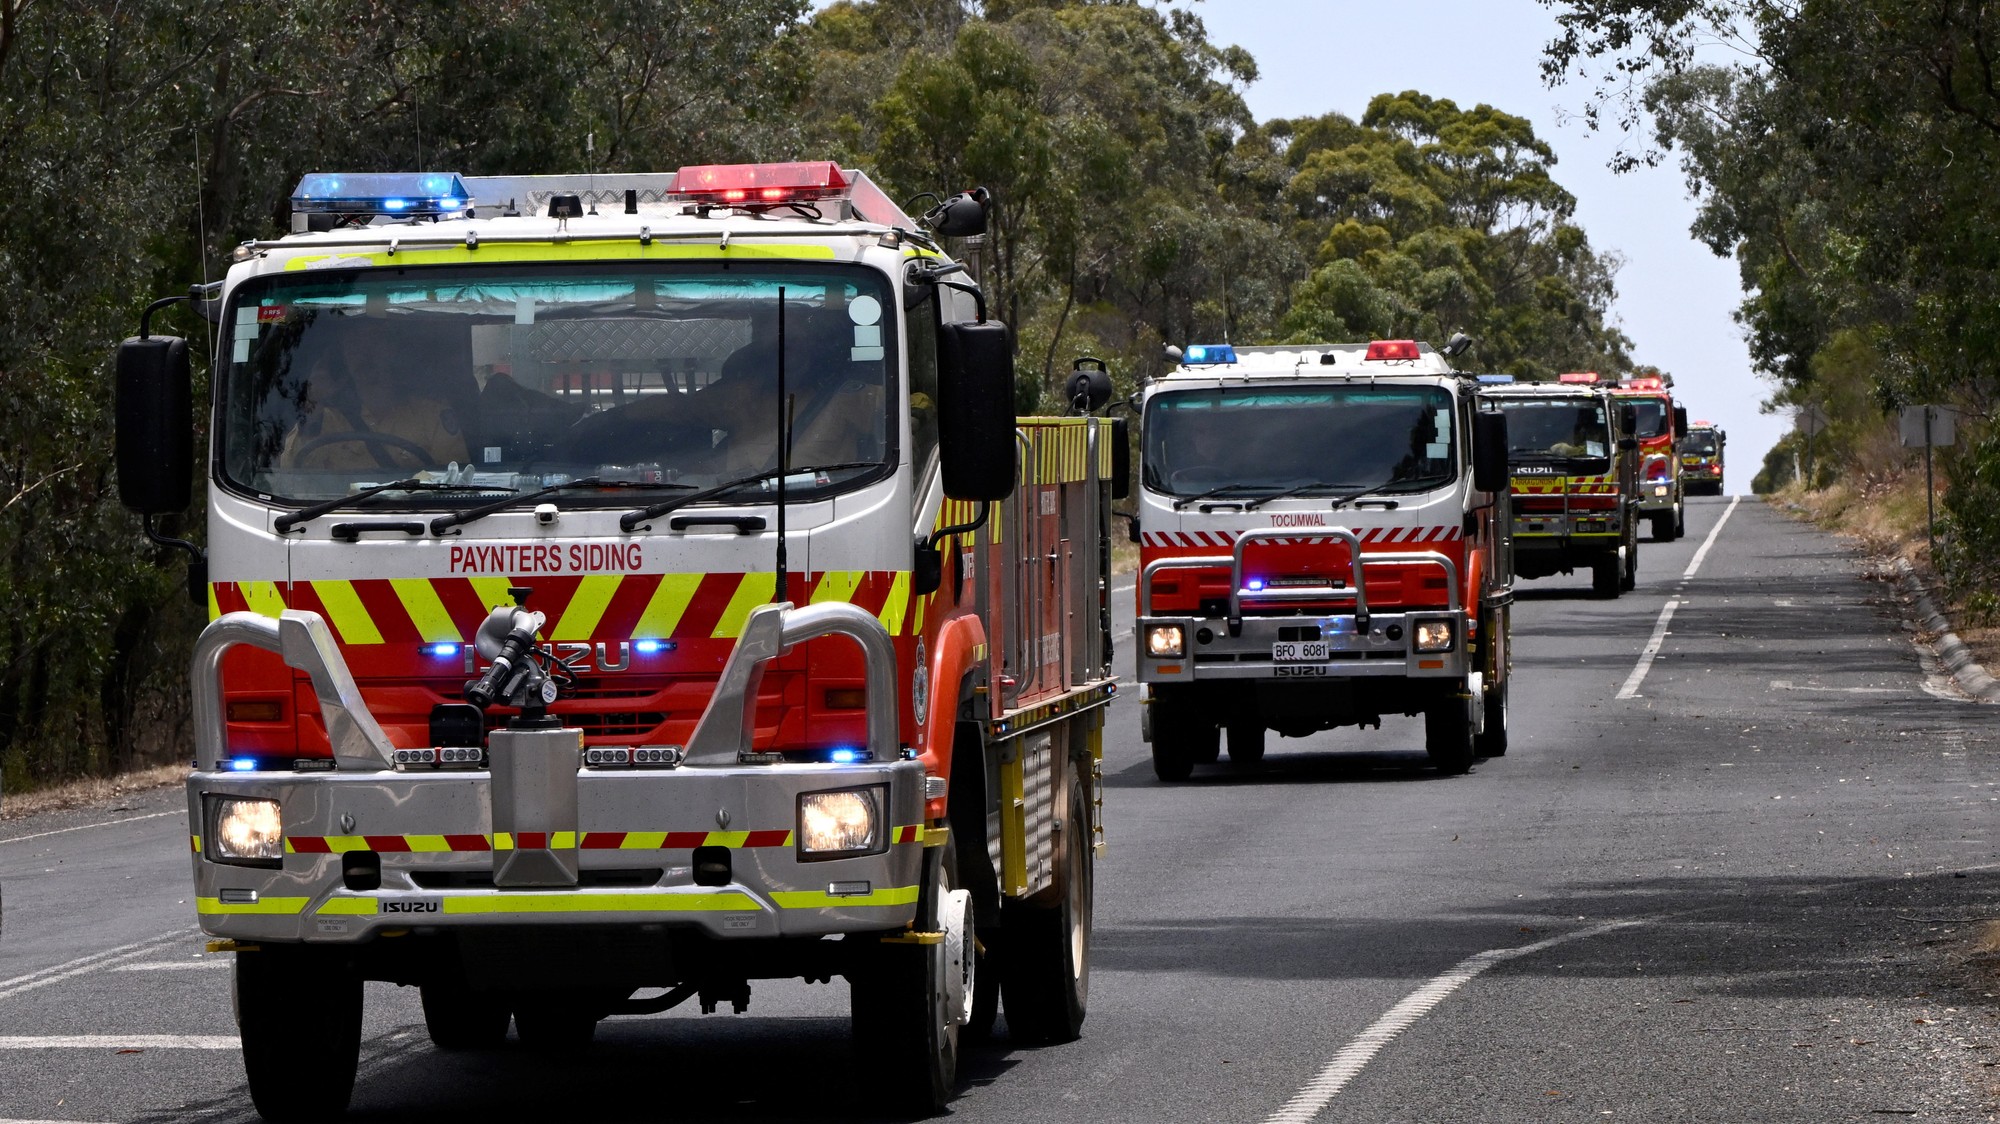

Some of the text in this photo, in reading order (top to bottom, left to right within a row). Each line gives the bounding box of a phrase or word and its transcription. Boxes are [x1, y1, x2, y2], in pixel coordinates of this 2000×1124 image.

[1270, 513, 1326, 527] TOCUMWAL
[450, 543, 642, 573] PAYNTERS SIDING
[1275, 644, 1326, 657] BFO 6081
[464, 641, 630, 674] IZU
[1273, 666, 1327, 676] ISUZU
[383, 902, 438, 913] ISUZU
